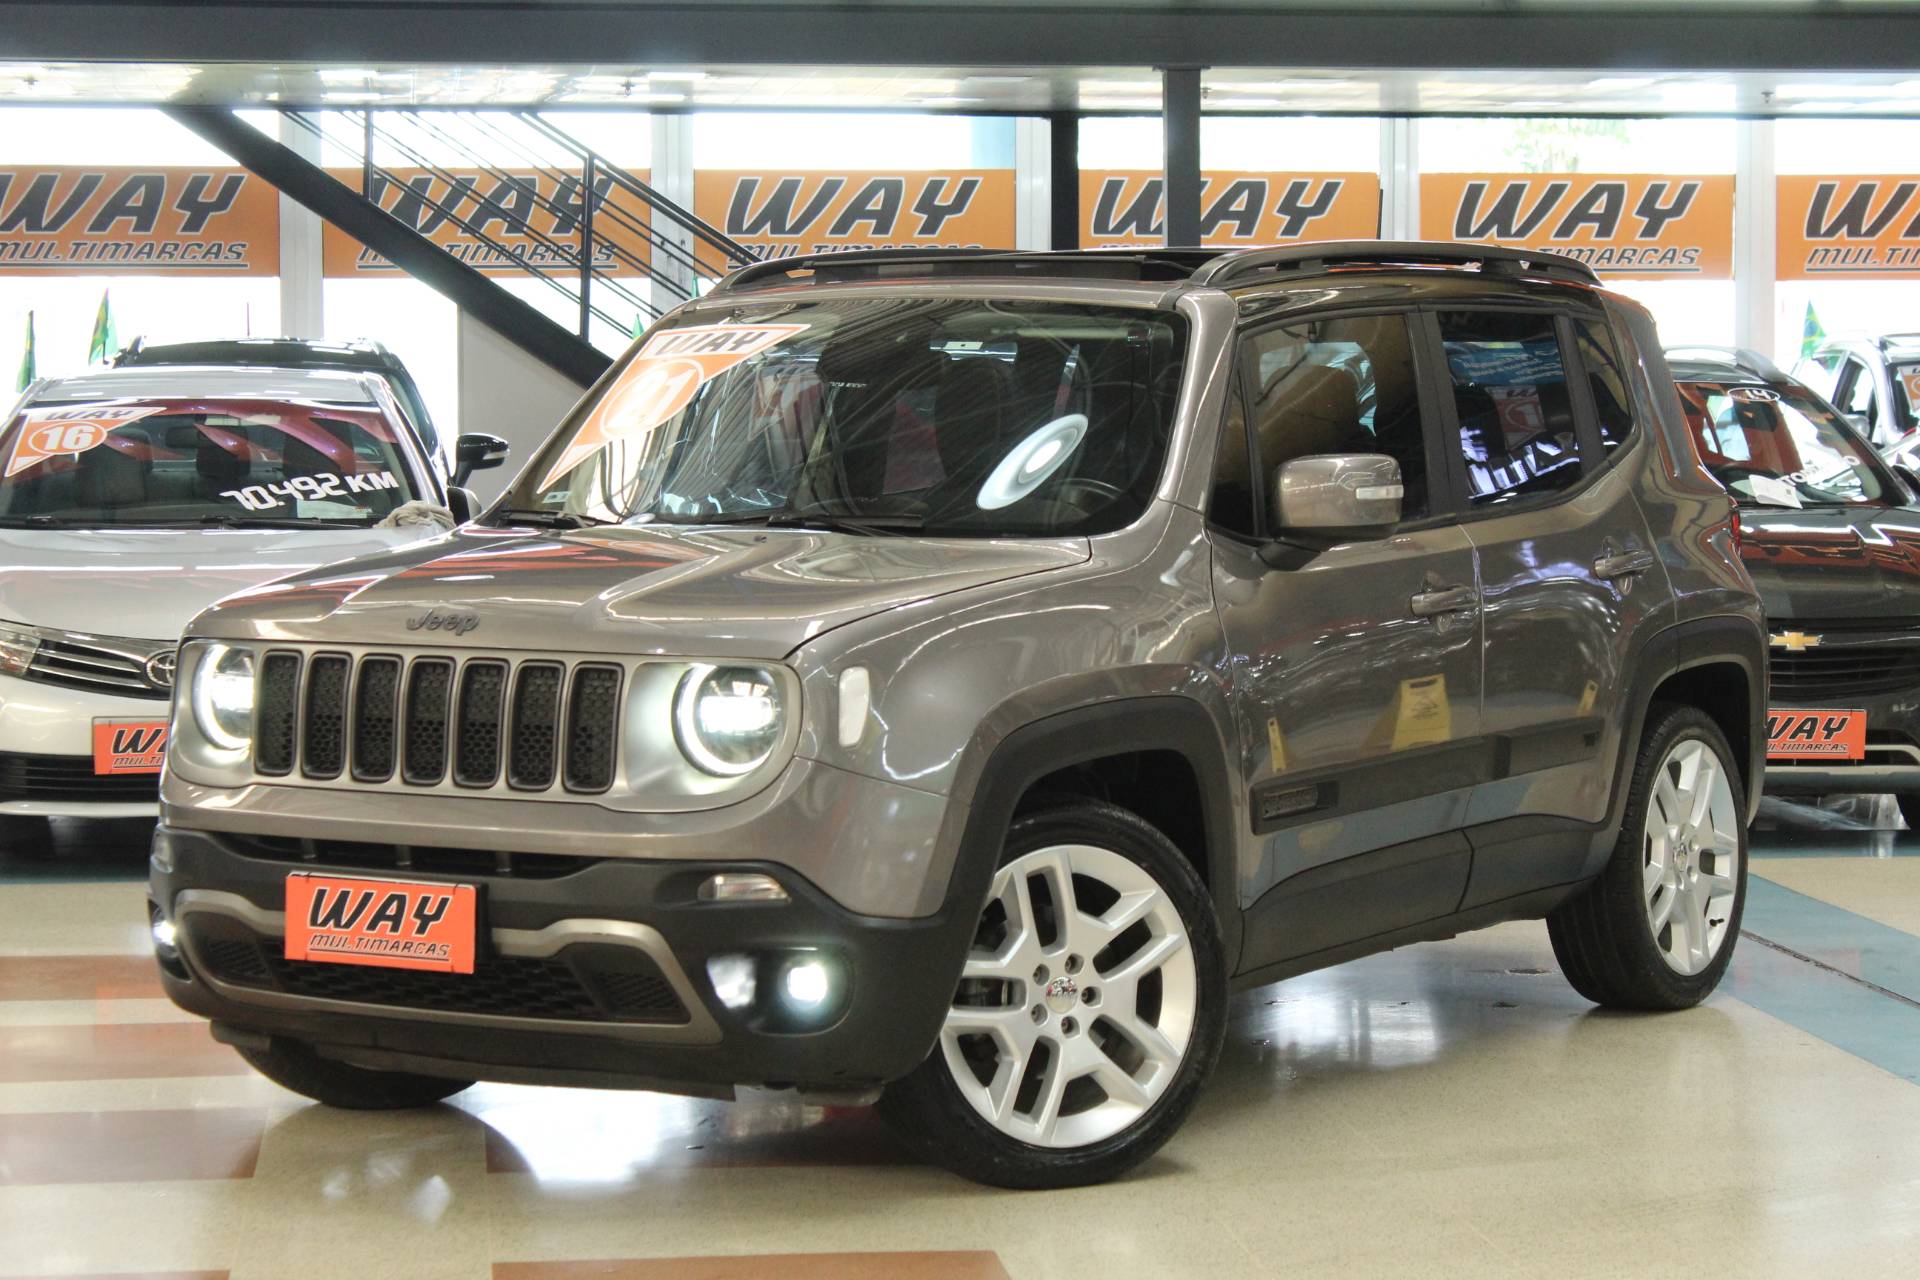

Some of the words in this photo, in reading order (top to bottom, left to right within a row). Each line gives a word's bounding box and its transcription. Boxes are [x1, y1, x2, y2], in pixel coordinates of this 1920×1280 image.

[0, 173, 248, 234] WAY
[725, 176, 983, 237] WAY
[1092, 176, 1345, 239] WAY
[1453, 181, 1702, 240] WAY
[1804, 181, 1920, 240] W
[1806, 247, 1920, 265] MULTI
[655, 331, 769, 355] WAY
[46, 410, 134, 420] WAY
[39, 425, 96, 450] 16
[219, 473, 348, 511] 10.492
[344, 471, 399, 493] KM
[406, 608, 479, 636] Jeep
[111, 728, 167, 754] W
[307, 886, 452, 936] WAY
[310, 934, 450, 957] MULTIMARCAS
